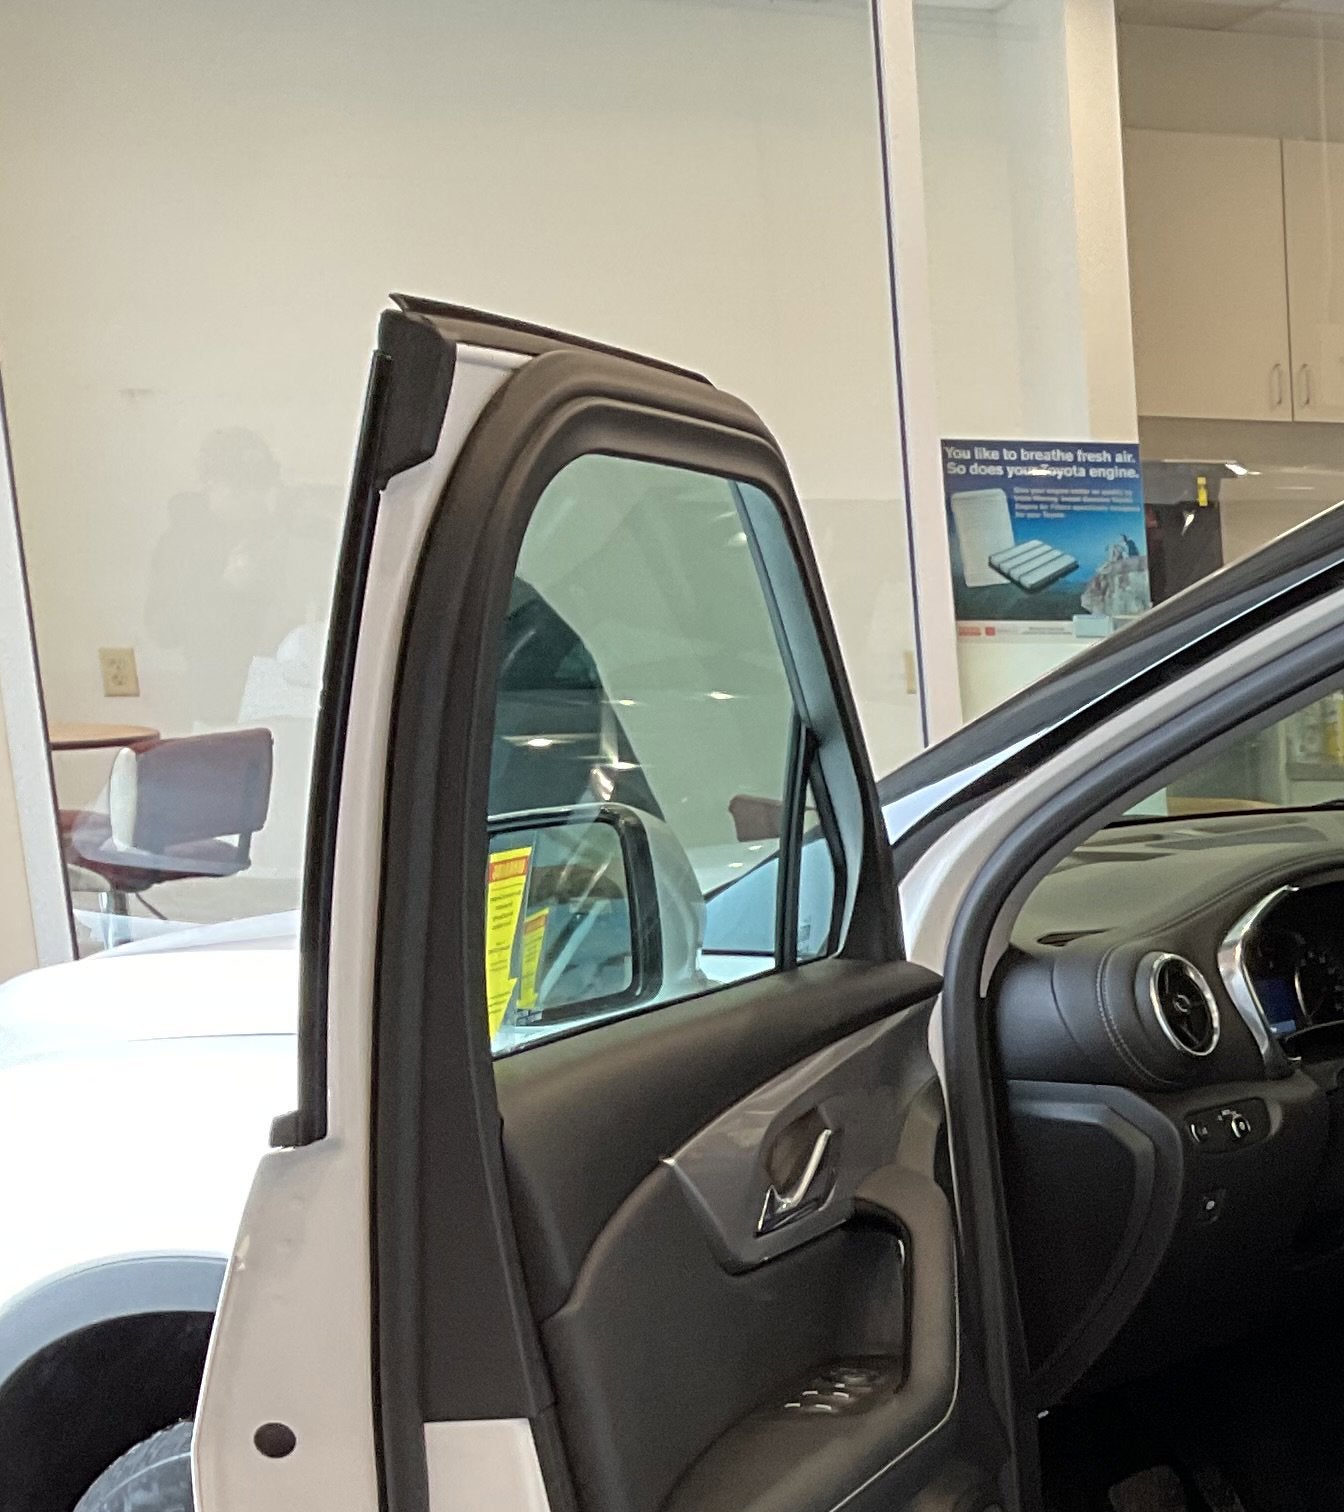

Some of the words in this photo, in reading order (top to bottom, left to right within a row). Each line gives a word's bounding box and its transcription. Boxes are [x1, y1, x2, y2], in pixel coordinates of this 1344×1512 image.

[945, 447, 971, 460] You
[975, 447, 1000, 460] like
[1002, 448, 1017, 461] to
[1020, 448, 1074, 462] breathe
[1077, 448, 1112, 463] fresh
[1115, 450, 1136, 464] air.
[947, 462, 967, 475] So
[969, 462, 1004, 475] does
[1005, 465, 1040, 479] you
[1089, 465, 1139, 480] engine.
